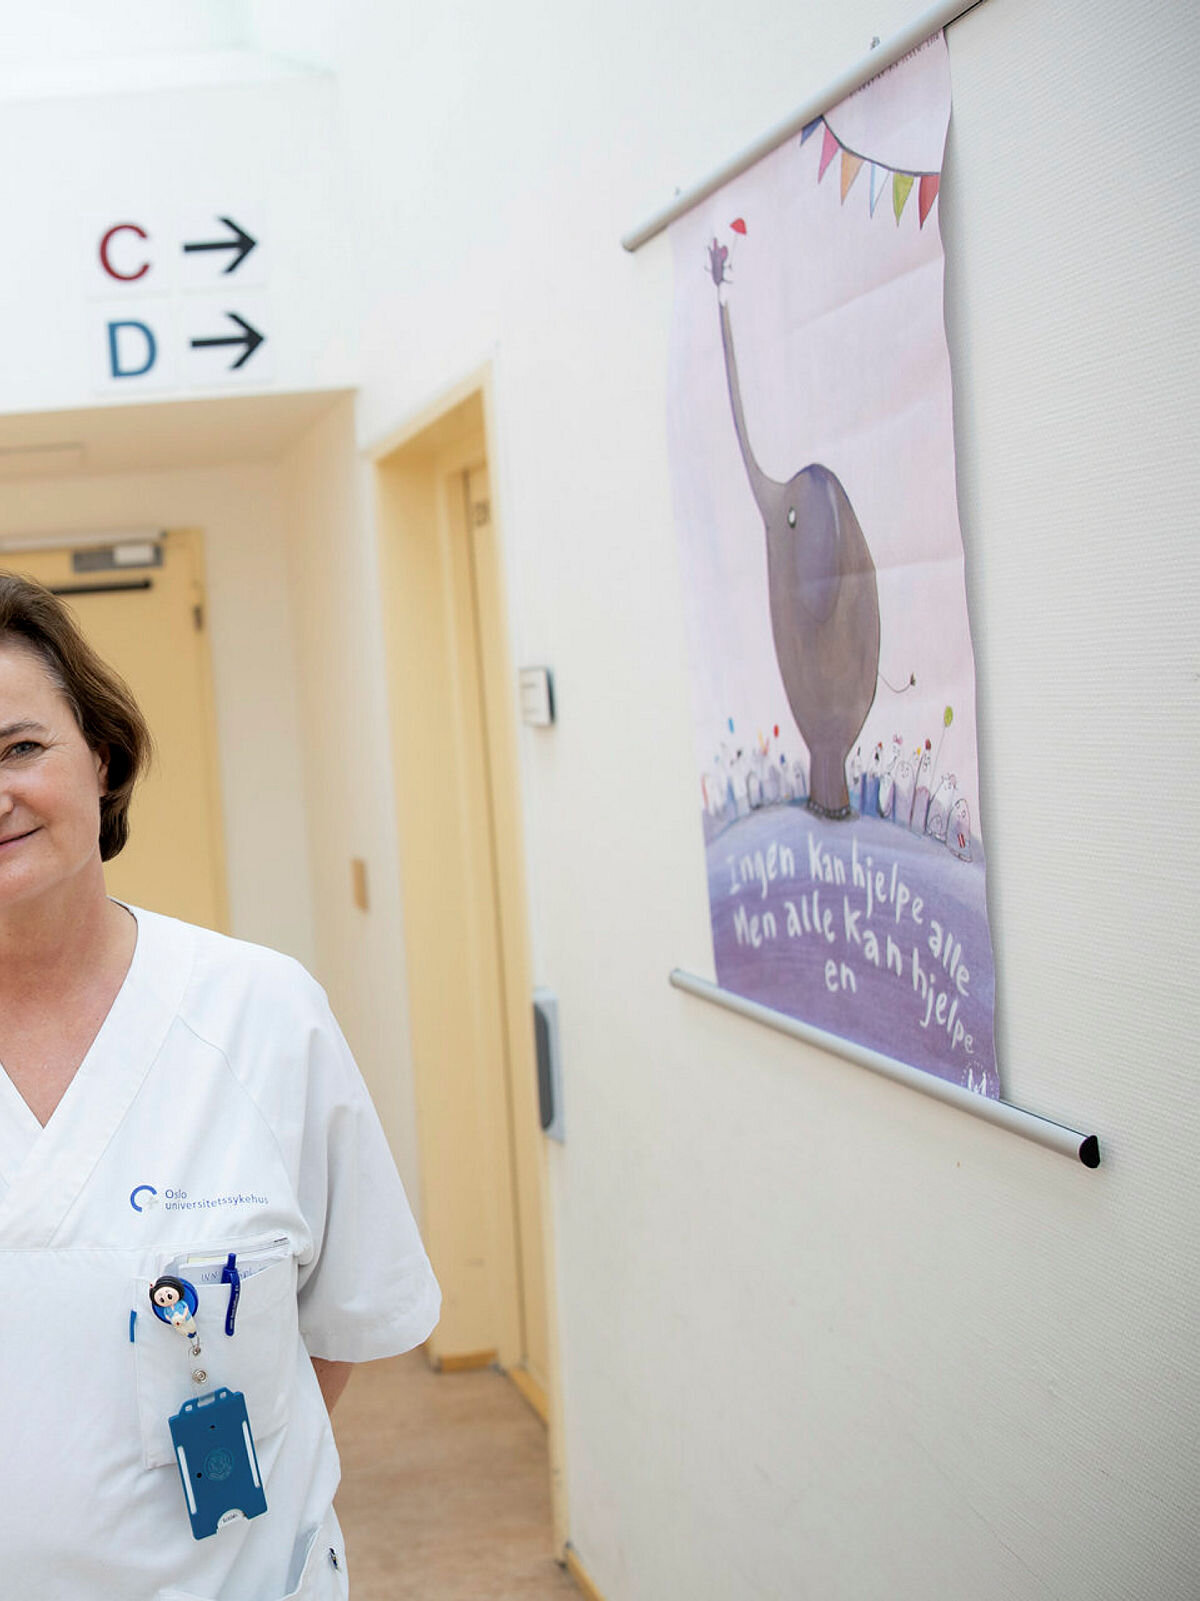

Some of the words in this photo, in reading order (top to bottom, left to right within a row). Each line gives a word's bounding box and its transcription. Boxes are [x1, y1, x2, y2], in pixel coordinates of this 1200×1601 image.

[98, 223, 151, 282] C
[106, 319, 159, 380] D
[726, 840, 796, 900] Ingen
[852, 833, 924, 925] hjelpe
[928, 920, 971, 997] alle
[784, 889, 836, 943] alle
[912, 947, 975, 1055] hjelpe
[824, 958, 857, 993] en
[164, 1188, 188, 1200] Oslo
[164, 1193, 270, 1211] universitetssykehus
